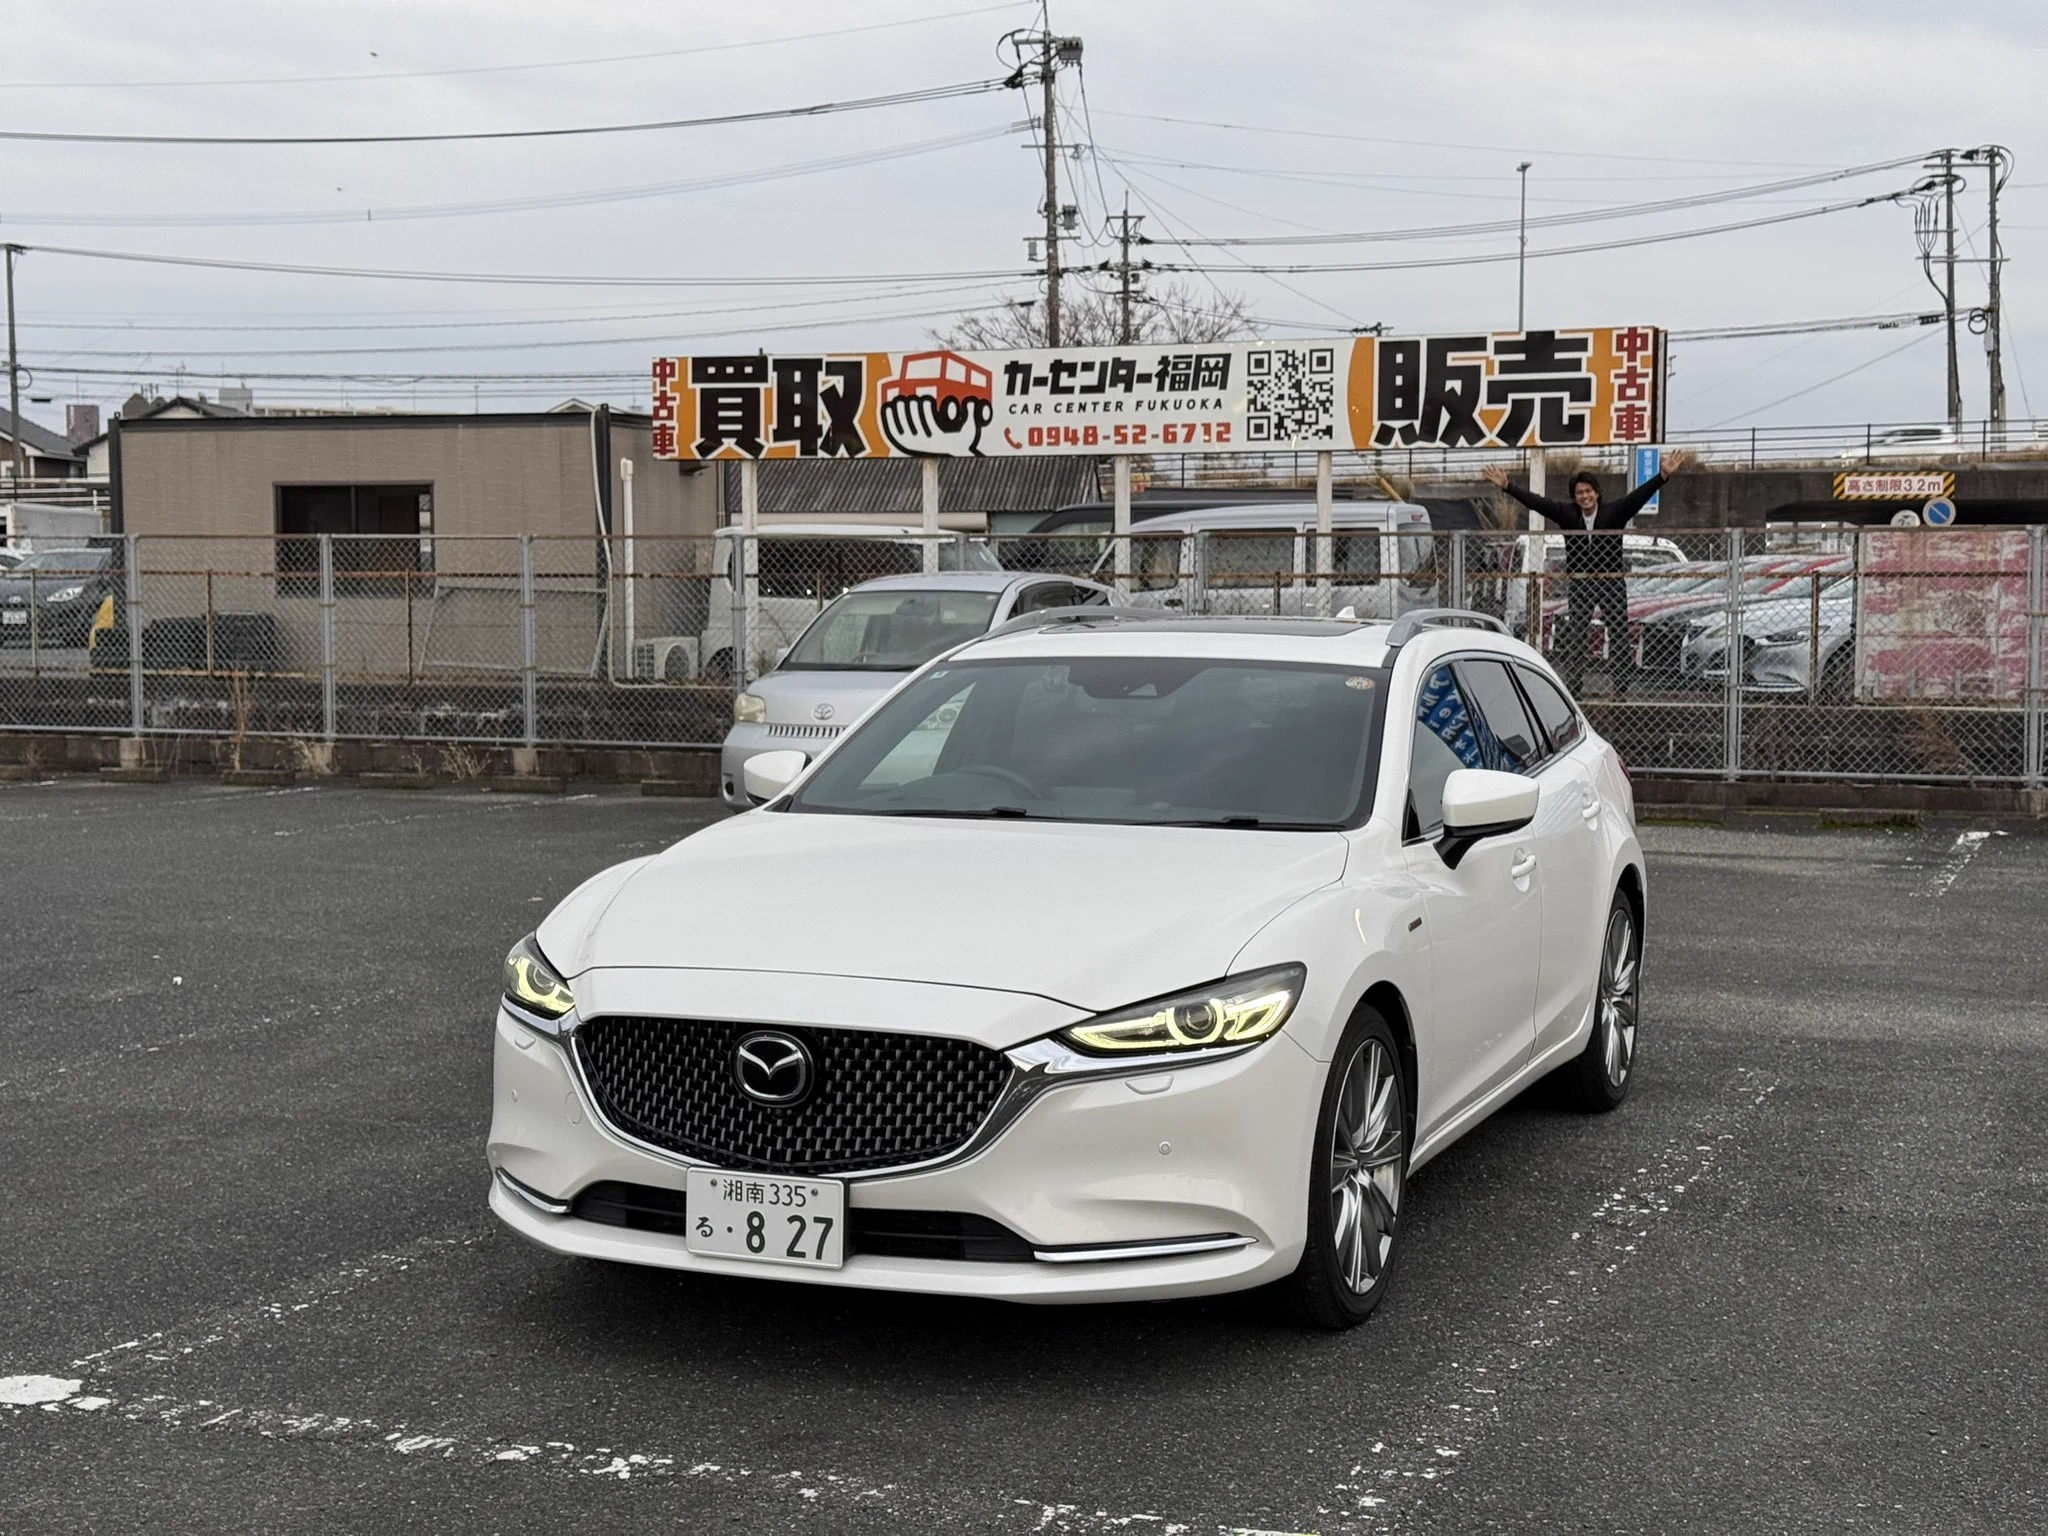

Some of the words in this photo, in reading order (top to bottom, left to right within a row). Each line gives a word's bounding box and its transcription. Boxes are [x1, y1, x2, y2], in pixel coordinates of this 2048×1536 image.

[653, 357, 676, 456] 中古車
[690, 356, 869, 458] 買取
[1004, 353, 1232, 395] カーセンター福岡
[1008, 403, 1043, 414] CAR
[1054, 401, 1125, 413] CENTER
[1135, 398, 1223, 411] FUKUOKA
[1373, 330, 1592, 447] 販売
[1614, 327, 1649, 441] 中古車
[1028, 422, 1231, 447] 0948-52-6712
[1847, 478, 1941, 492] 高さ制限3.2m
